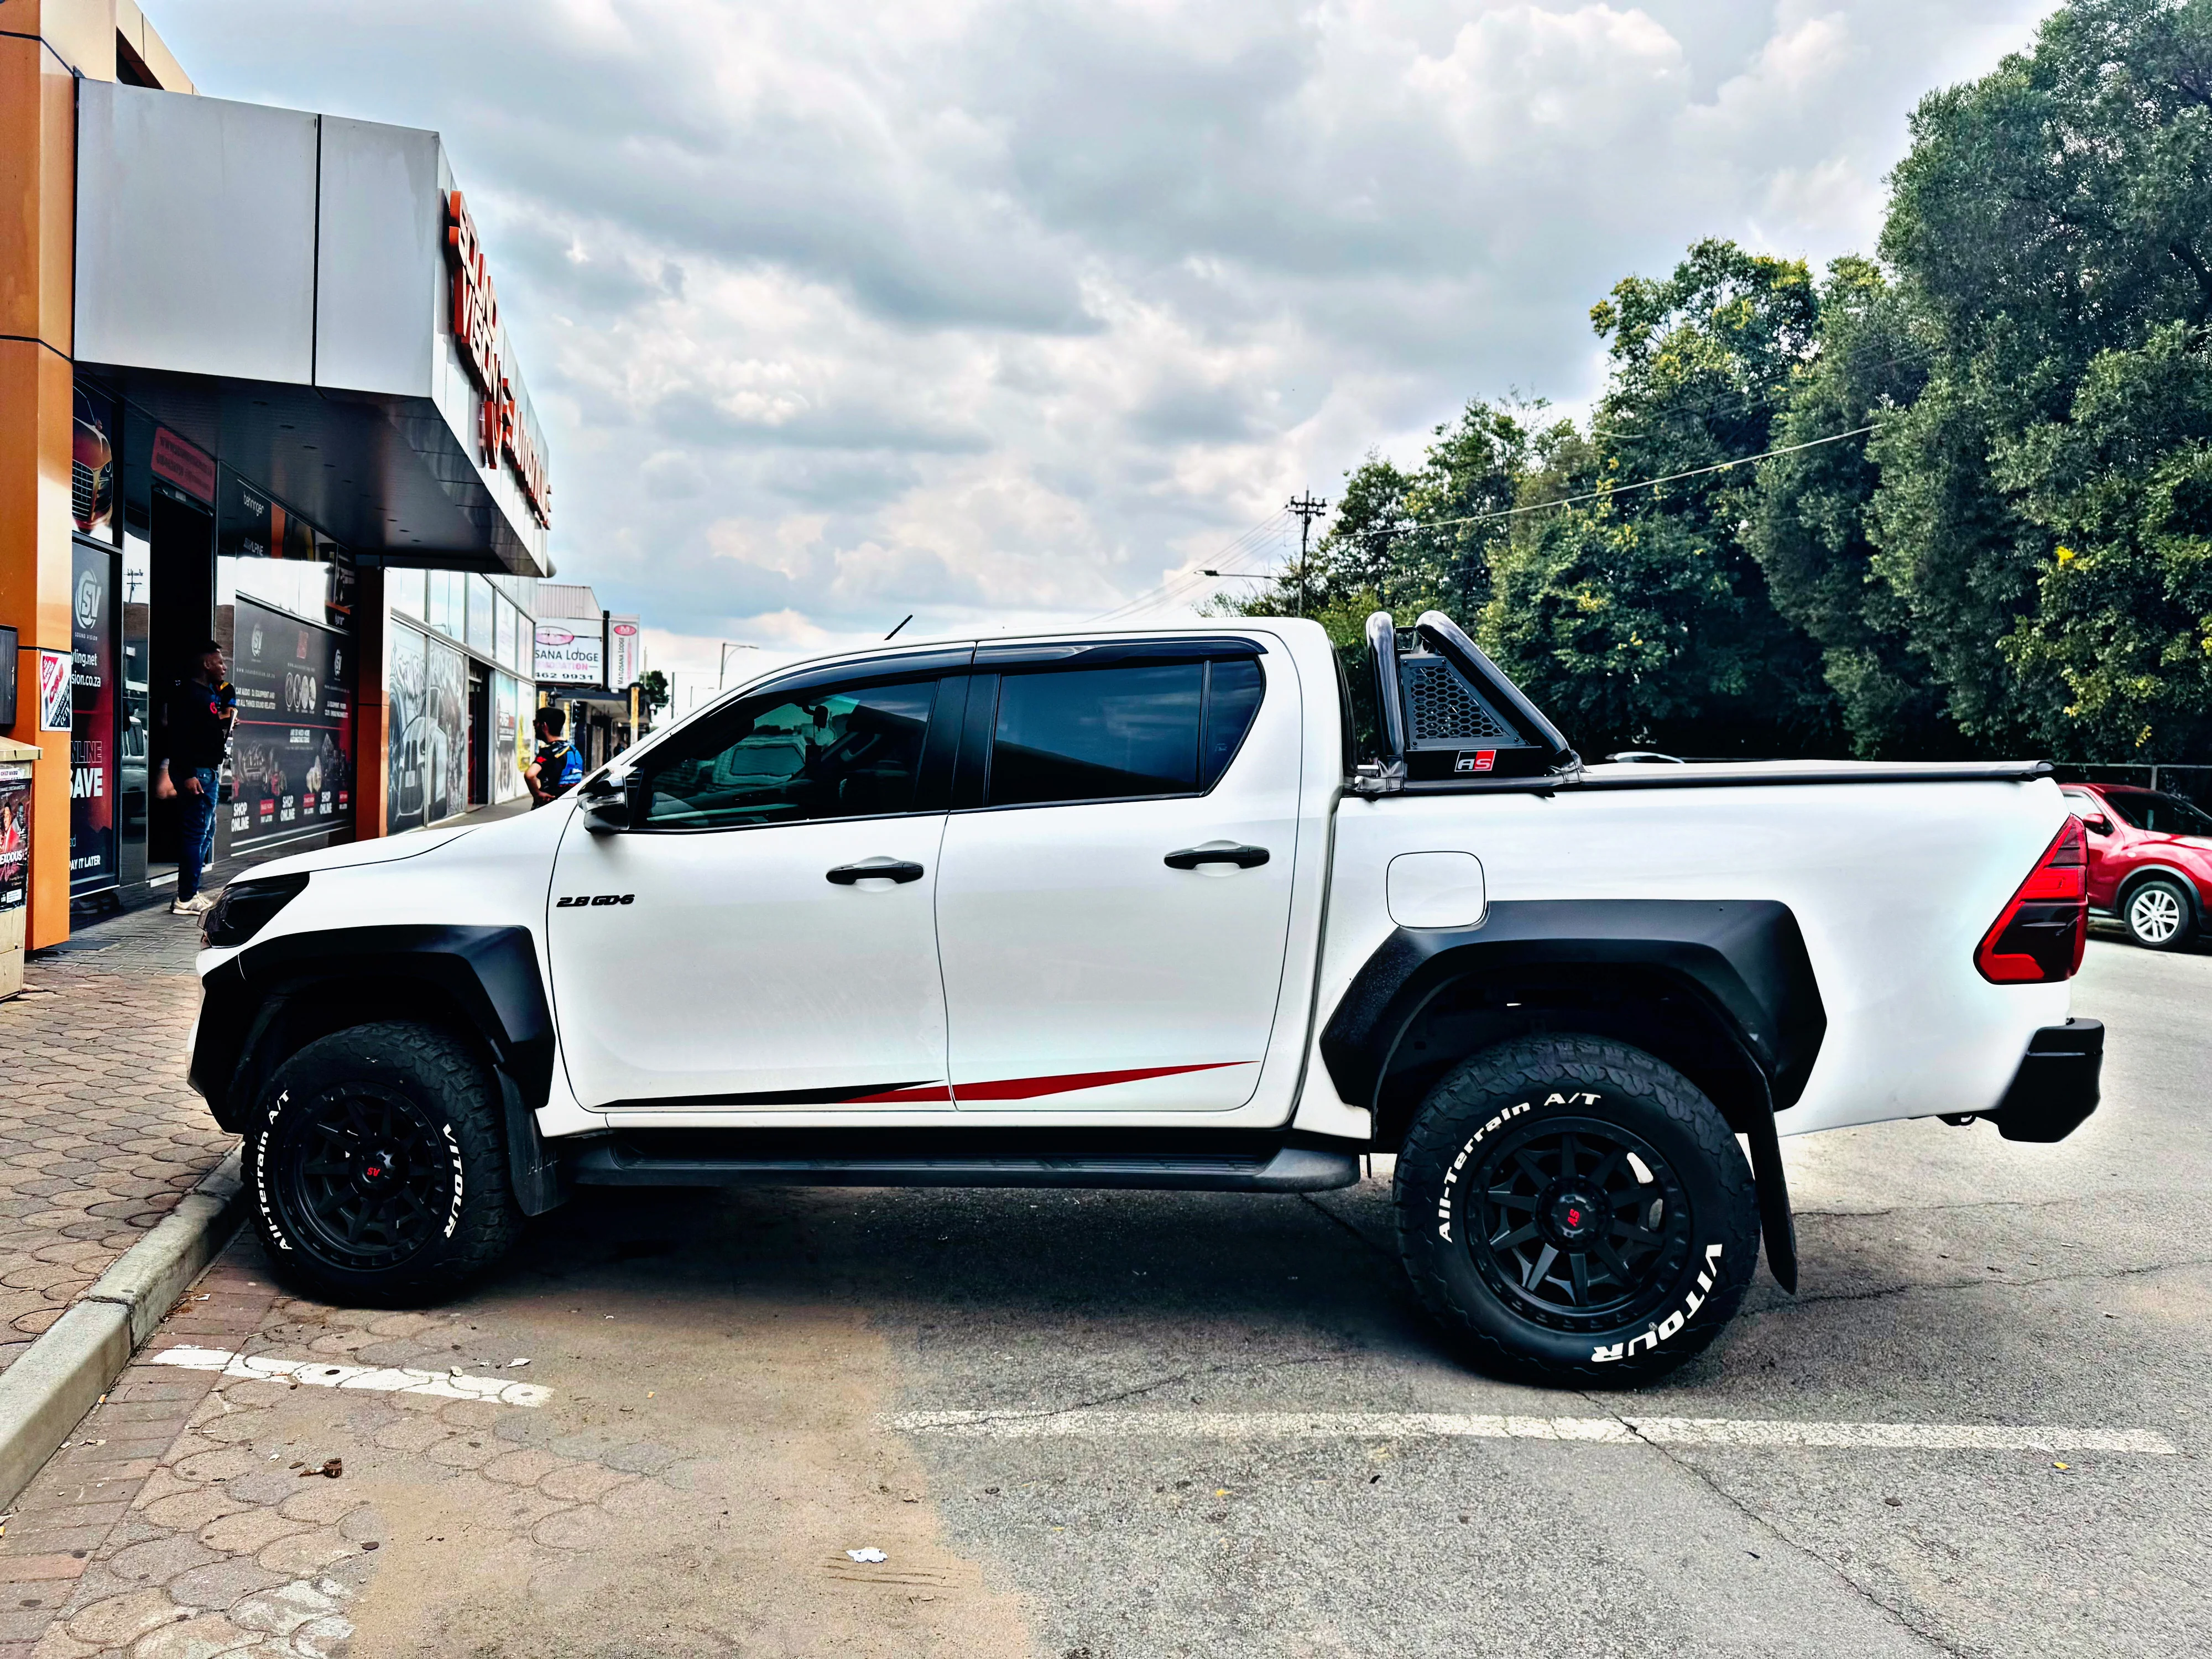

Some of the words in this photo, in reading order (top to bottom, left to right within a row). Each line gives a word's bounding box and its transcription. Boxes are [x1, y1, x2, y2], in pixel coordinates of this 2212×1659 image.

[448, 190, 498, 341] SOUND
[455, 265, 499, 405] VISION
[535, 650, 562, 660] SANA
[566, 650, 598, 662] LODGE
[71, 671, 101, 687] sion.co.za
[1457, 759, 1492, 770] AS
[233, 802, 247, 816] SHOP
[280, 808, 295, 821] ONLINE
[231, 816, 249, 832] ONLINE
[0, 850, 22, 865] EXODUS
[70, 859, 78, 870] AY
[79, 858, 84, 869] IT
[84, 855, 101, 868] LATER
[591, 894, 635, 906] GD-6
[268, 1090, 289, 1124] A/T
[1438, 1102, 1531, 1244] All-Terrain
[1543, 1092, 1601, 1107] A/T
[442, 1124, 463, 1238] VITOUR
[257, 1131, 293, 1250] All-Terrain
[1591, 1244, 1723, 1362] VITOUR
